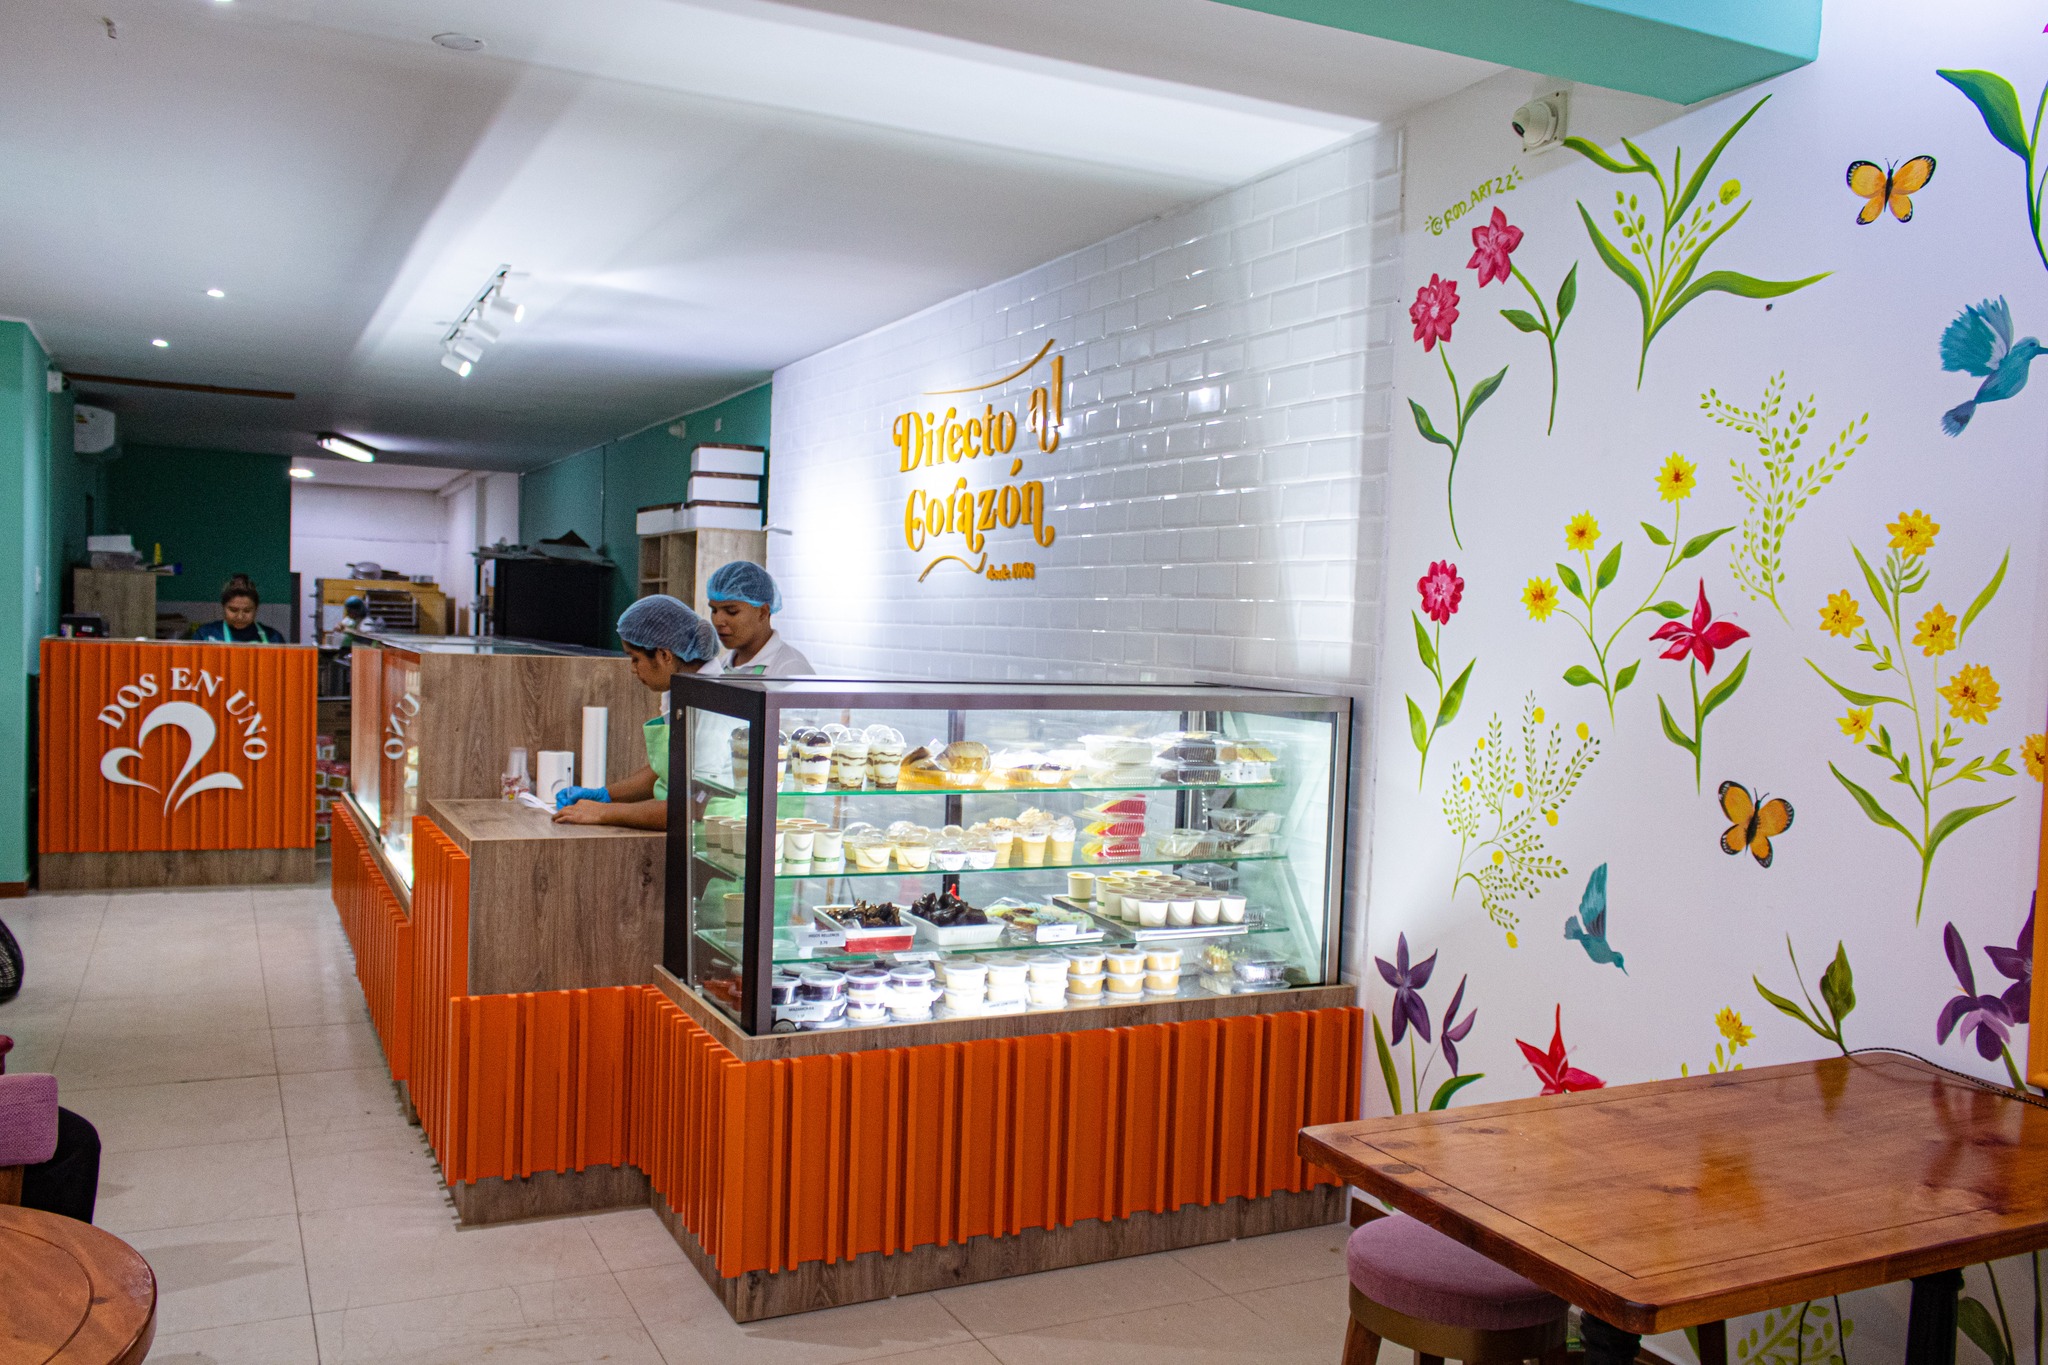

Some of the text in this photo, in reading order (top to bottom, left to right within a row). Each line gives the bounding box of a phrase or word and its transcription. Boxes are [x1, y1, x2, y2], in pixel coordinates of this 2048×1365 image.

[892, 354, 1064, 472] Directo al
[904, 457, 1055, 553] Corazón
[97, 667, 268, 761] DOS EN UNO
